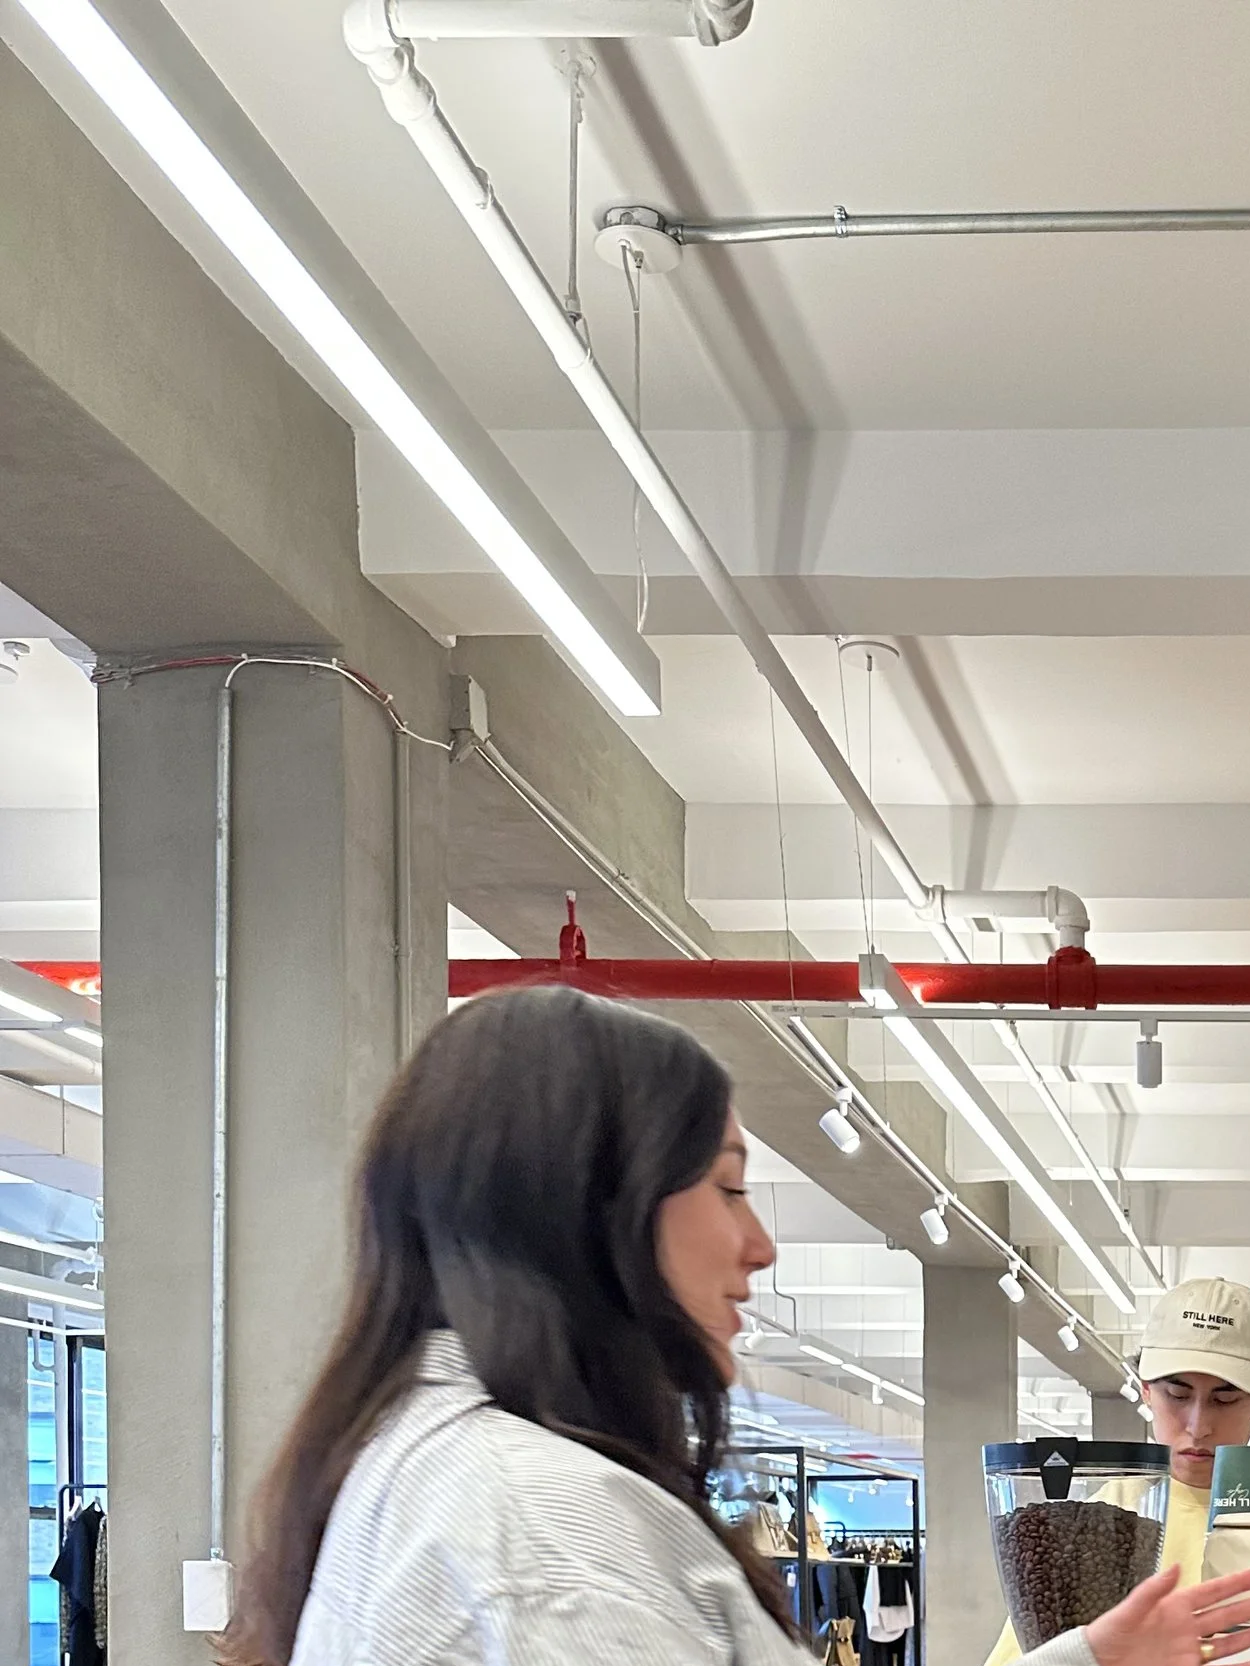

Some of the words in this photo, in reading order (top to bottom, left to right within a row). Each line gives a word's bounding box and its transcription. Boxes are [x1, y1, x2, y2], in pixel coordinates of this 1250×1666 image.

[1182, 1310, 1207, 1322] STILL
[1208, 1314, 1235, 1326] HERE
[1212, 1497, 1237, 1507] HERE
